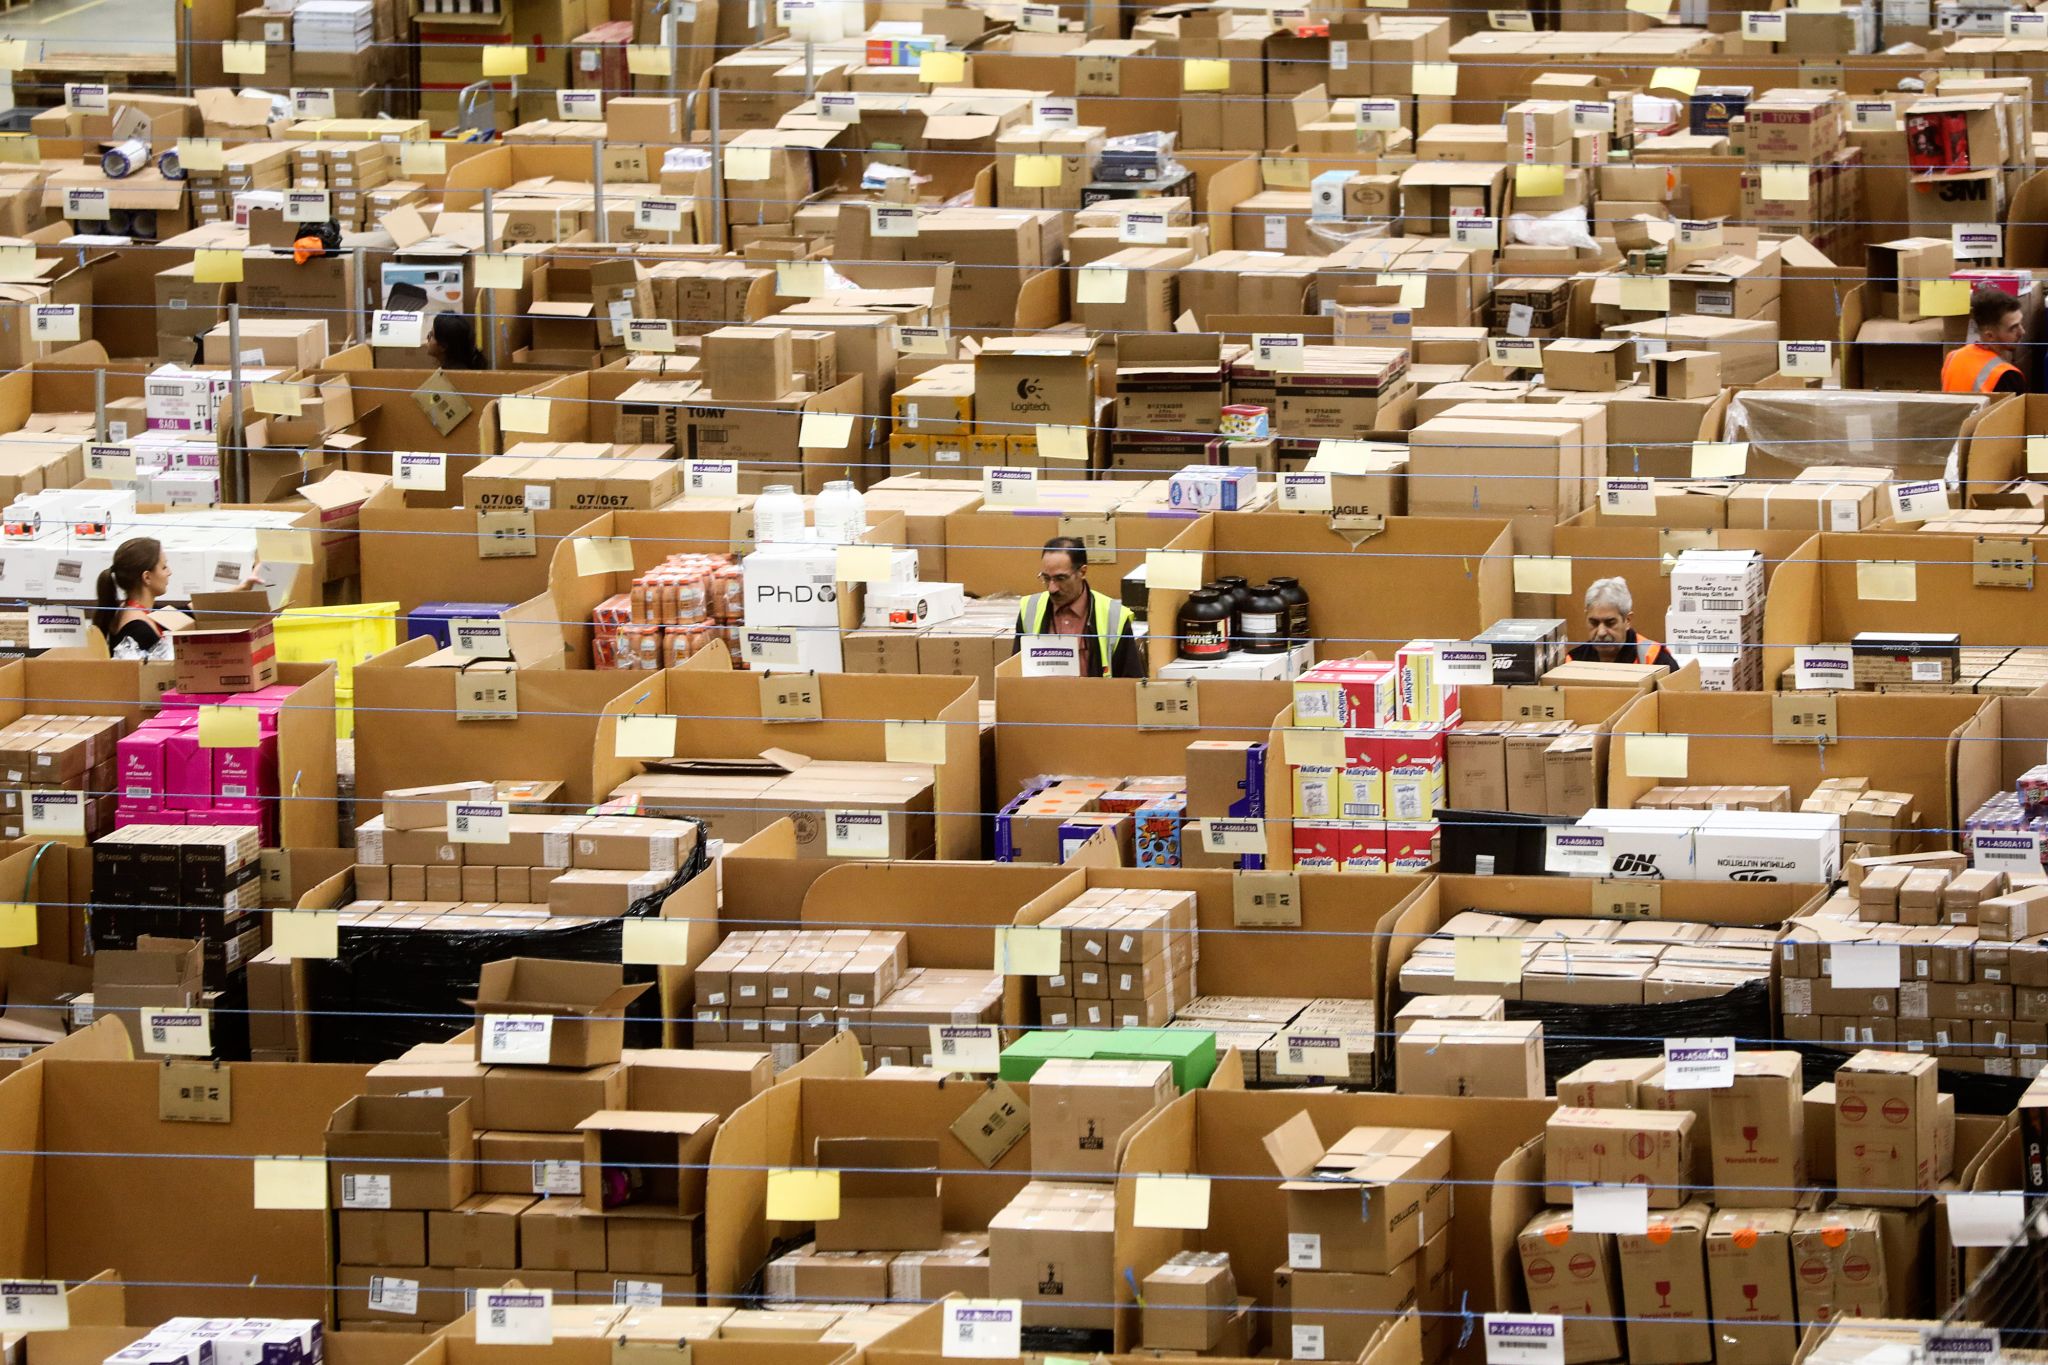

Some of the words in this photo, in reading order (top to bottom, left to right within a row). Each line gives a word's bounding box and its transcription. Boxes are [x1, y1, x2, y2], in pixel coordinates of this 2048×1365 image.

[1774, 113, 1800, 121] TOYS
[1938, 178, 1988, 203] 3M
[688, 406, 725, 418] TOMY
[1011, 402, 1049, 413] Logitech
[159, 420, 179, 429] TOYS
[576, 494, 629, 505] 07/067
[1099, 535, 1106, 546] A1
[758, 585, 813, 603] PhD
[1404, 668, 1413, 704] Milkybar
[499, 689, 507, 701] A1
[803, 692, 811, 703] A1
[1181, 699, 1188, 711] A1
[1337, 690, 1346, 724] Milkybar
[1546, 706, 1553, 717] A1
[1818, 714, 1826, 725] A1
[1346, 768, 1377, 776] Milkybar
[1393, 768, 1426, 776] Milkybar
[105, 853, 132, 861] TASSIMO
[149, 853, 176, 861] TASSIMO
[193, 853, 222, 861] TASSIMO
[1301, 859, 1333, 867] Milkybar
[1348, 859, 1380, 867] Milkybar
[1396, 860, 1429, 868] Milkybar
[1612, 853, 1657, 873] ON
[1717, 859, 1756, 867] NUTRITION
[1280, 893, 1288, 905] A1
[1641, 903, 1649, 915] A1
[209, 1087, 218, 1100] A1
[1003, 1103, 1014, 1116] A1
[1725, 1156, 1756, 1164] Vorsicht
[1758, 1156, 1779, 1164] Glas!
